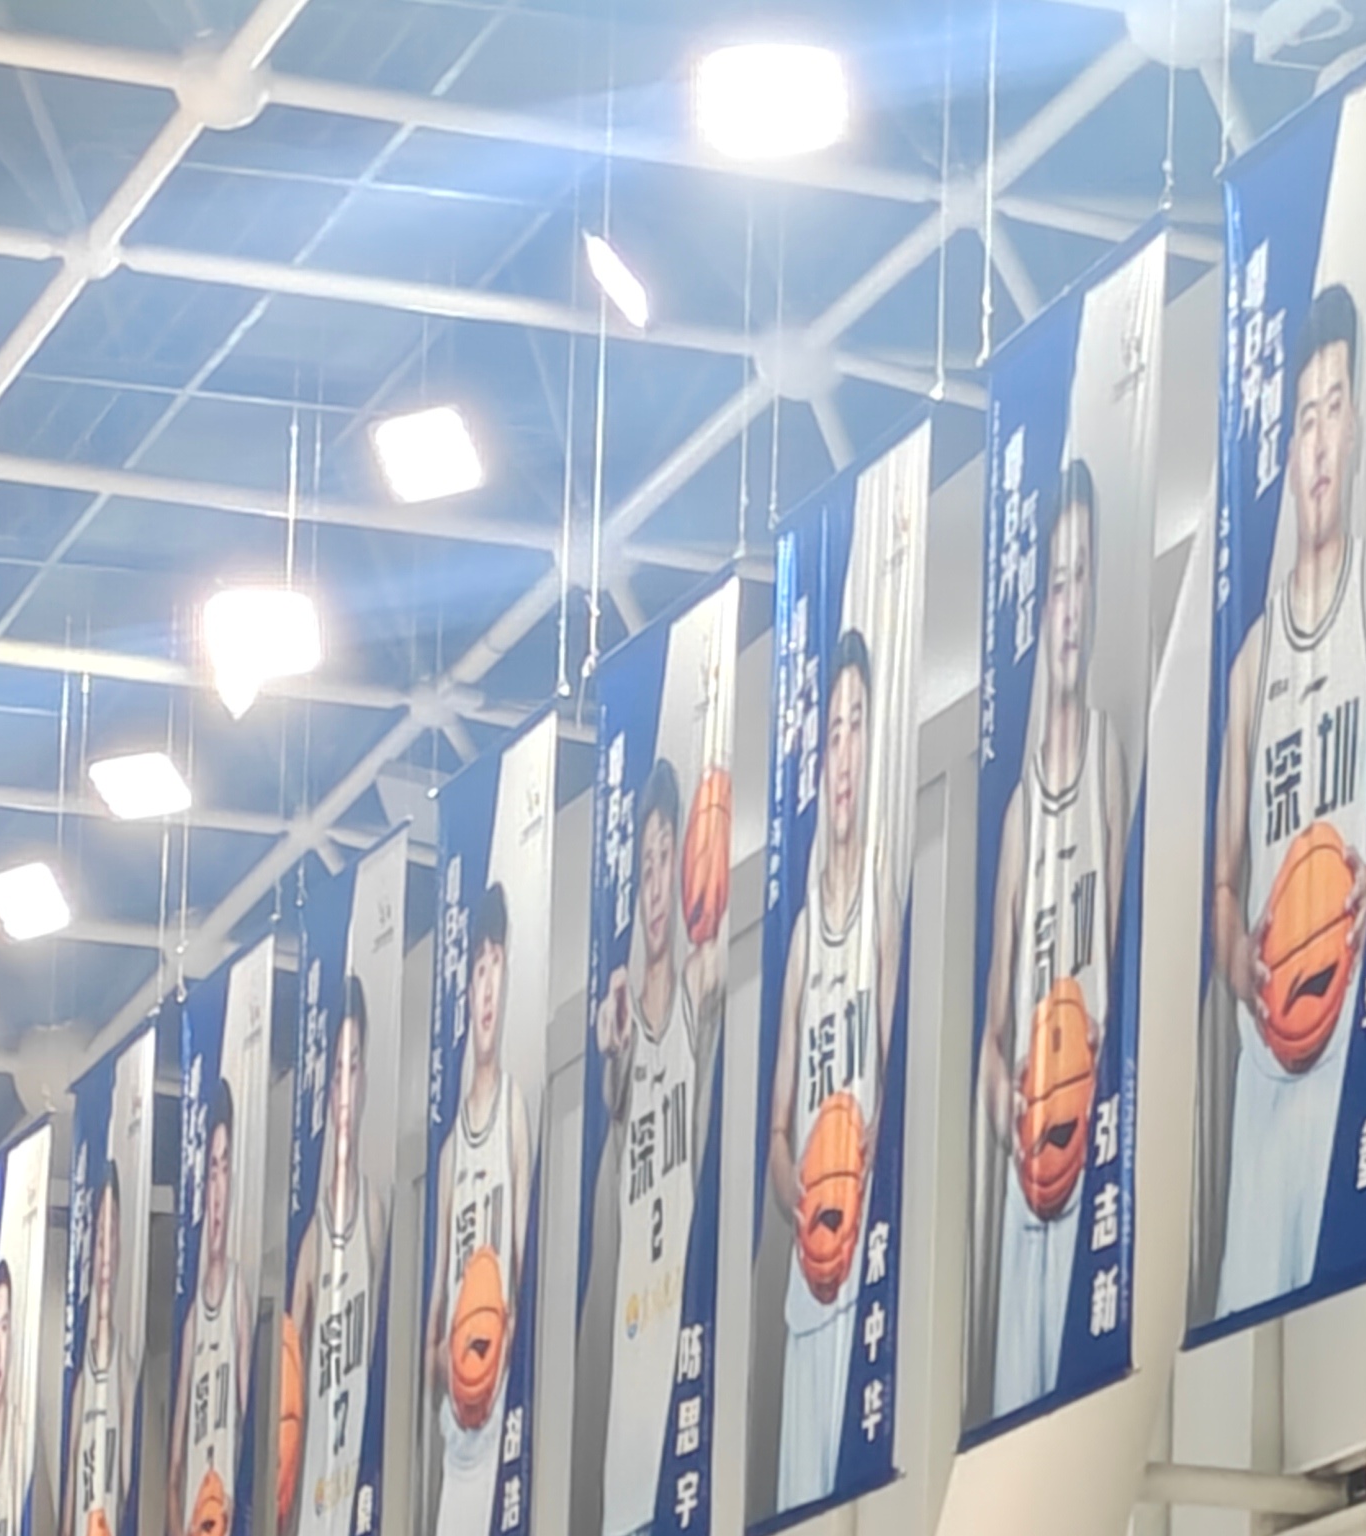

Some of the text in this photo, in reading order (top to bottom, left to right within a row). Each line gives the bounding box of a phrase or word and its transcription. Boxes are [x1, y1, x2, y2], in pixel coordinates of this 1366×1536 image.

[1264, 694, 1361, 847] 深圳
[808, 987, 871, 1113] 深圳
[628, 1080, 688, 1206] 深圳
[650, 1196, 664, 1264] 2
[1089, 1092, 1121, 1337] 张志新
[318, 1290, 366, 1399] 深圳
[860, 1221, 891, 1443] 宋中华
[193, 1362, 231, 1447] 深圳
